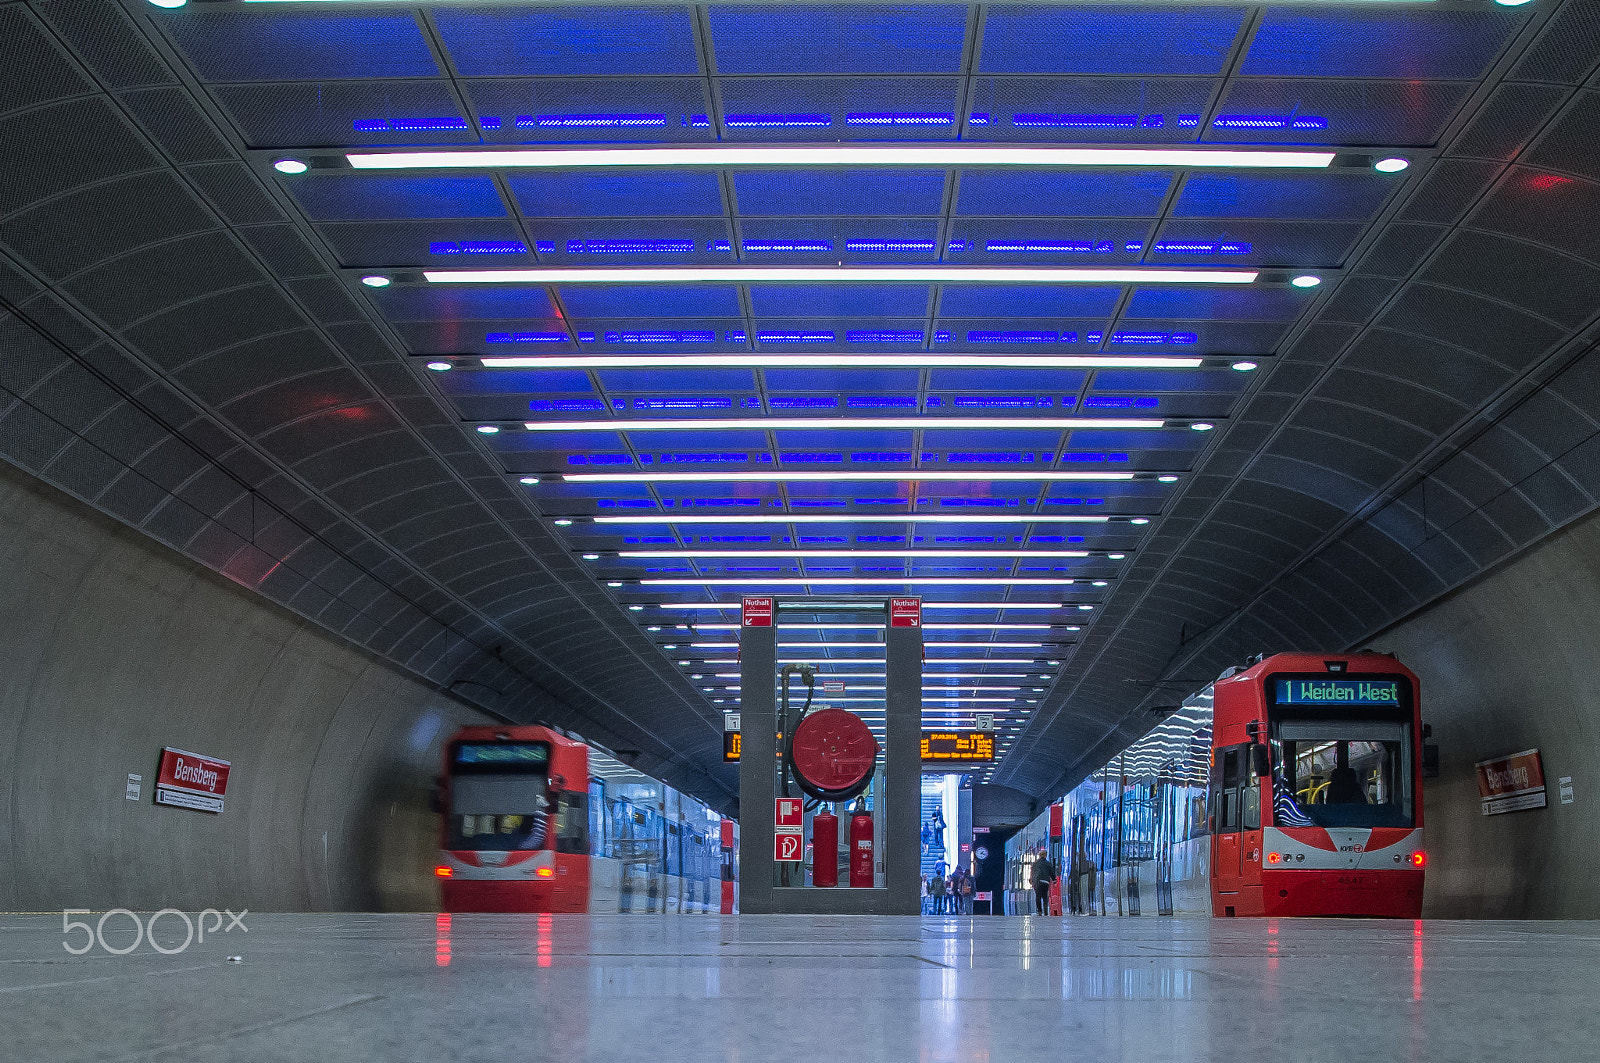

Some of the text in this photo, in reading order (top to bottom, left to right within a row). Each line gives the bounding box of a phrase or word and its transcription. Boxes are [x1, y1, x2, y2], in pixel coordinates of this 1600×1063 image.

[1285, 680, 1398, 703] 1 Weiden West
[174, 757, 218, 792] Bensberg
[1486, 766, 1529, 790] Bensberg
